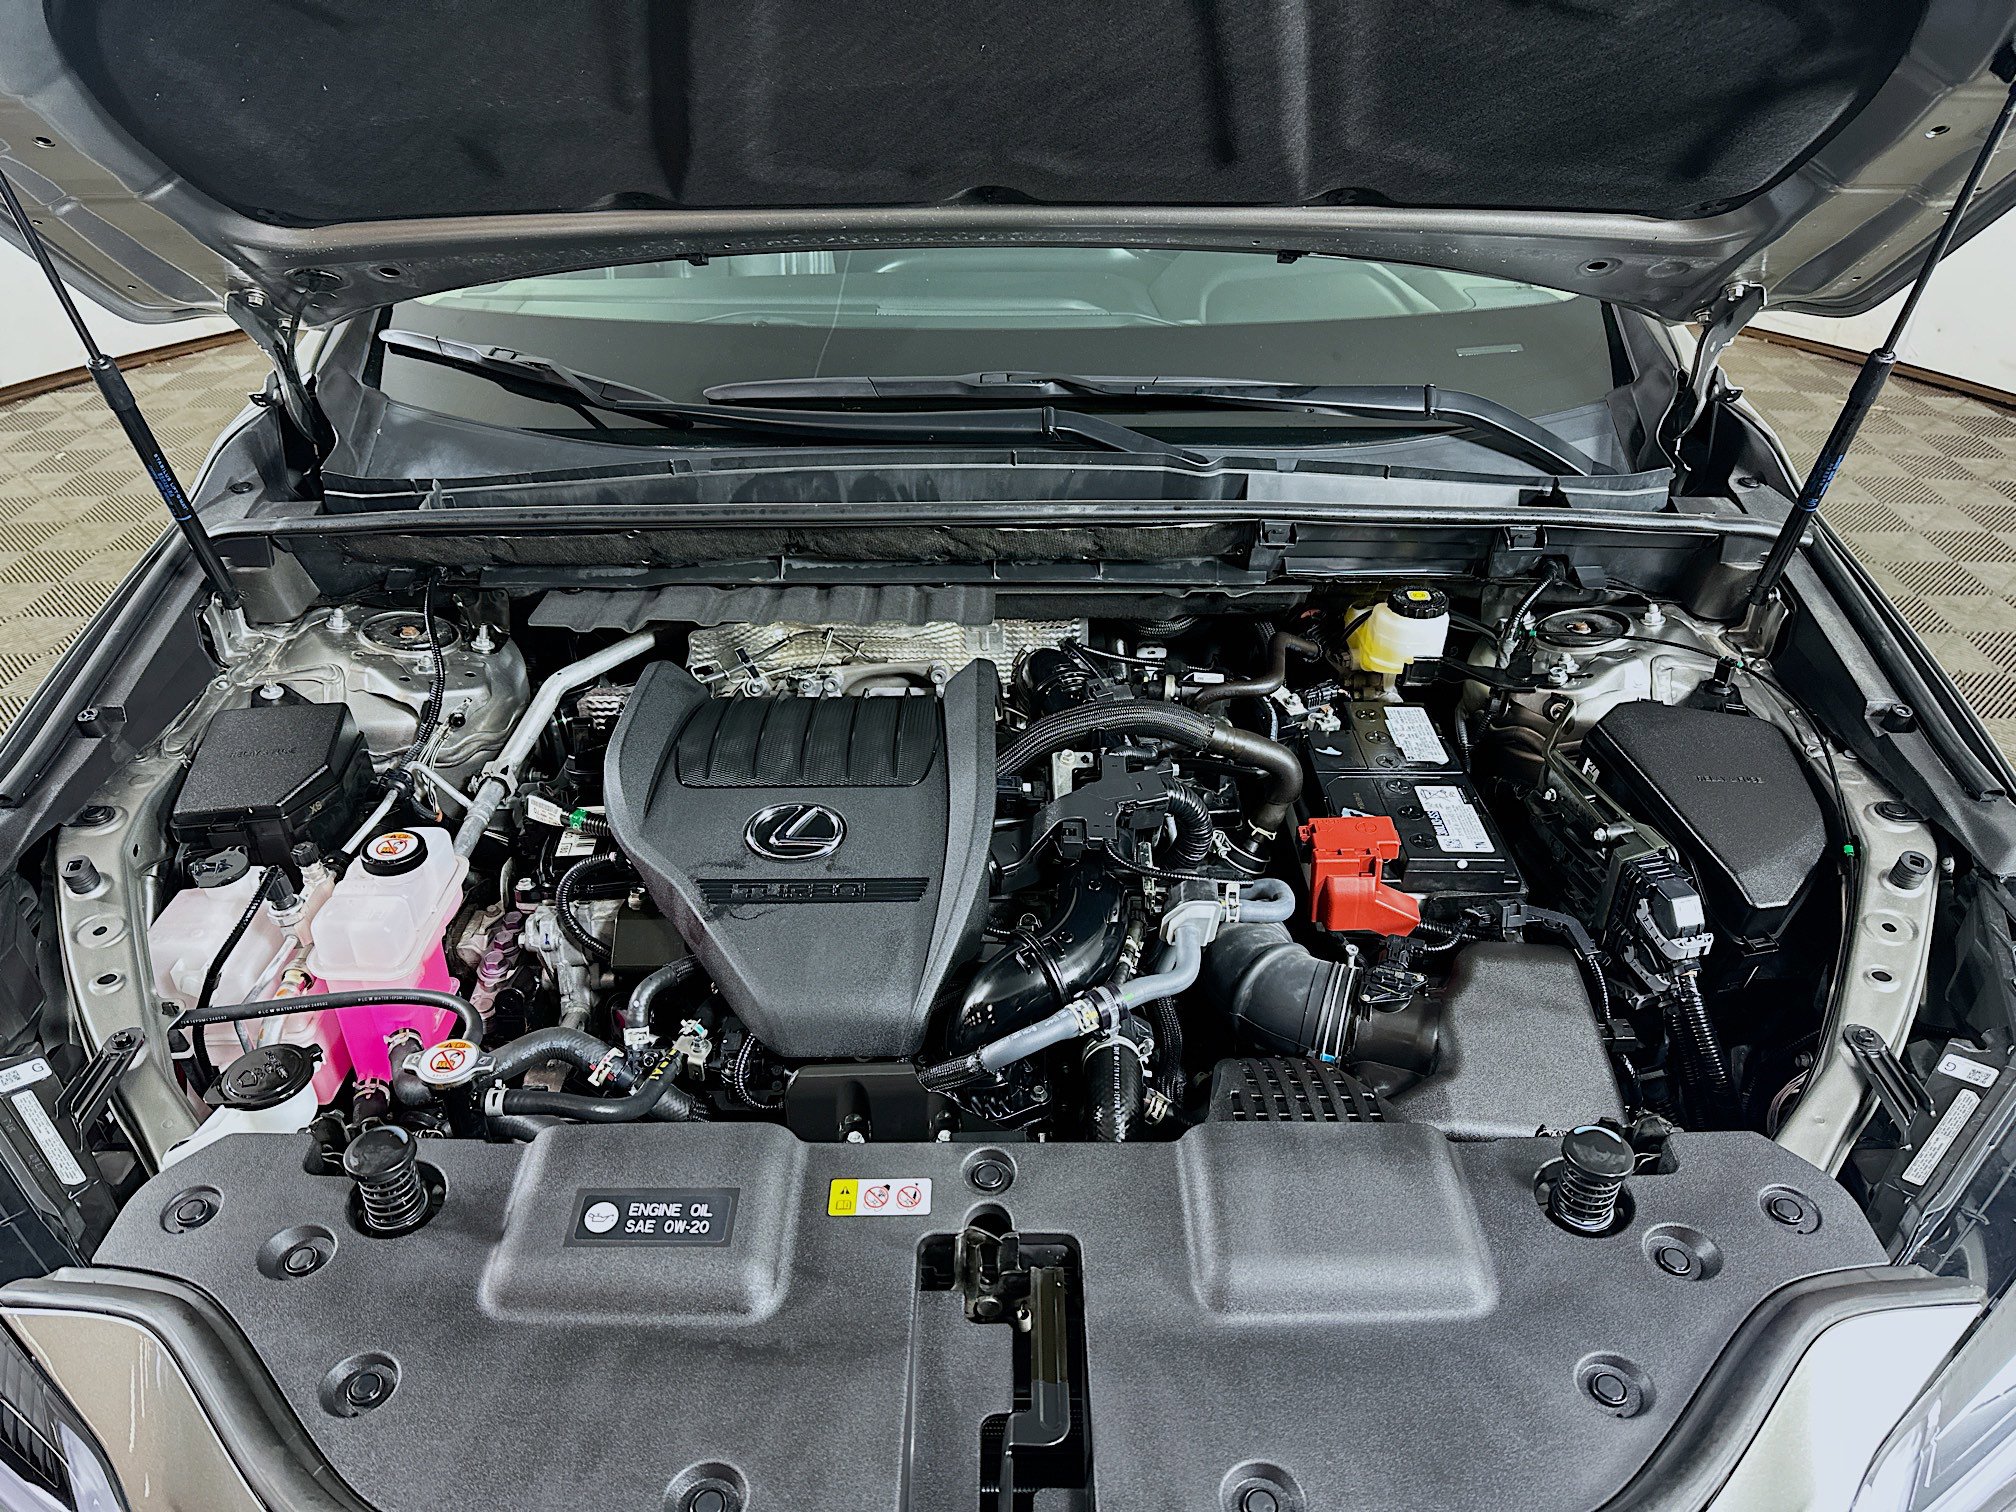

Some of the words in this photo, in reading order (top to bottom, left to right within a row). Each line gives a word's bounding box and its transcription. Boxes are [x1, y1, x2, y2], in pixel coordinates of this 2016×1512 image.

[31, 1062, 45, 1074] G
[628, 1202, 683, 1217] ENGINE
[690, 1203, 713, 1218] OIL
[624, 1219, 656, 1234] SAE
[663, 1220, 710, 1234] 0W-20
